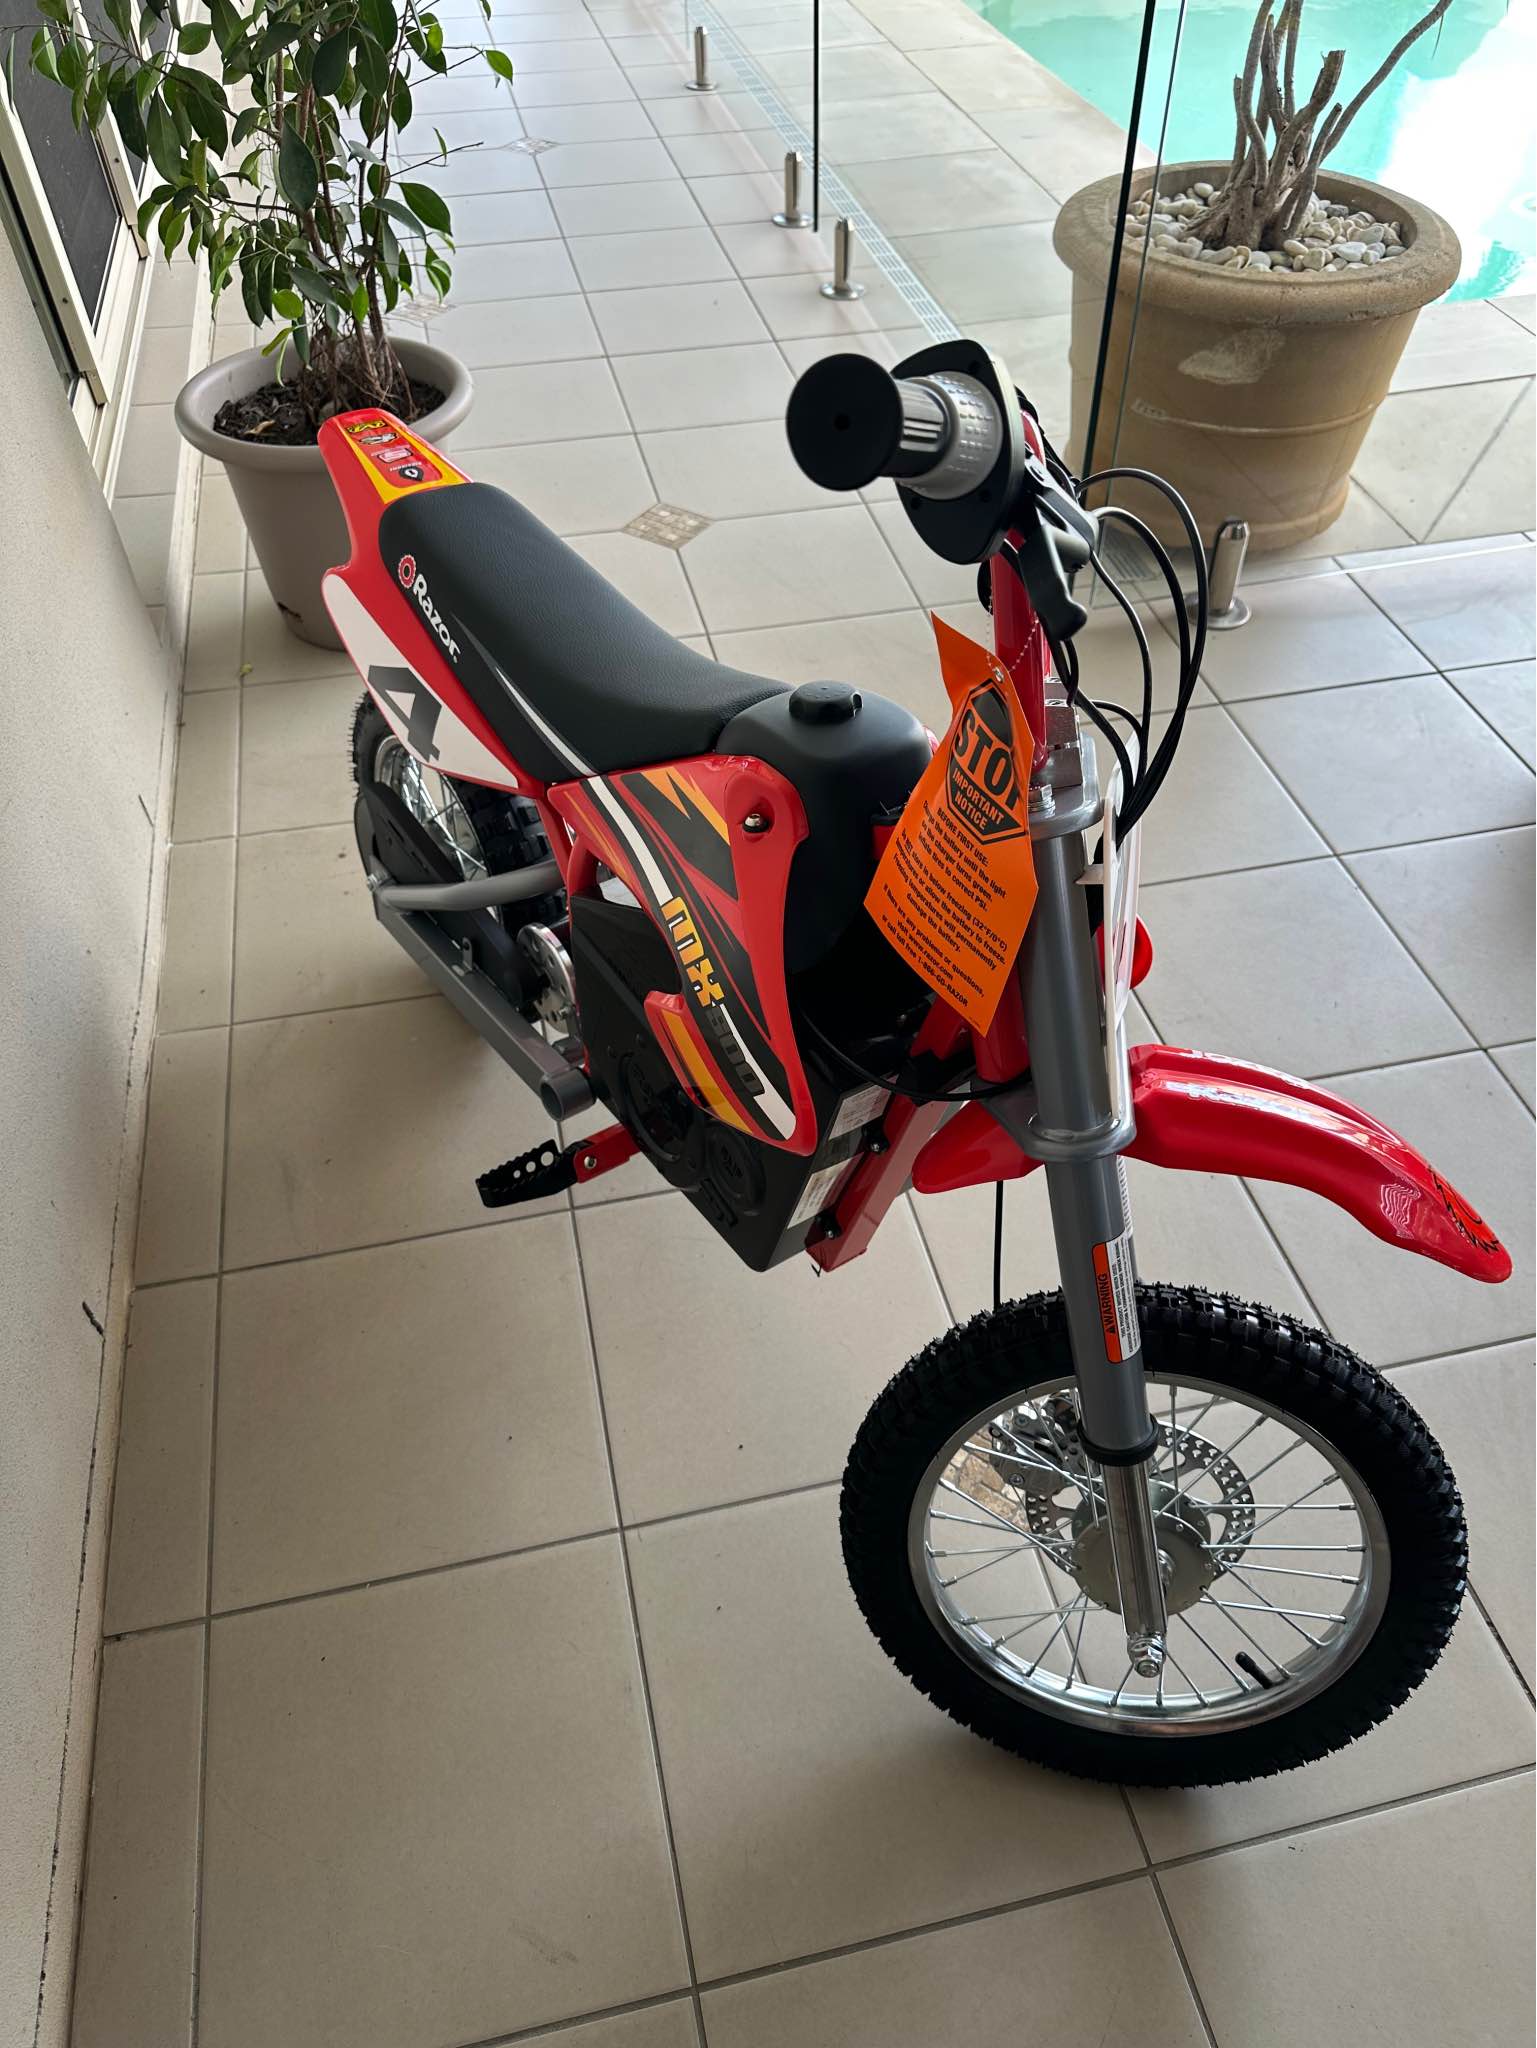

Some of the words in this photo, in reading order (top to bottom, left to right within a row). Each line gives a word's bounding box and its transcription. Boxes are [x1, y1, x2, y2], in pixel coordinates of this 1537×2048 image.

[412, 573, 462, 656] Razor
[367, 664, 442, 763] 4
[952, 767, 1005, 825] IMPORTANT
[954, 791, 988, 830] NOTICE
[937, 807, 957, 835] BEFORE
[957, 830, 974, 851] FIRST
[927, 828, 935, 842] the
[934, 840, 956, 865] charger
[956, 862, 972, 882] turns
[973, 880, 993, 903] green.
[932, 852, 945, 869] tires
[945, 866, 952, 877] to
[952, 875, 975, 900] correct
[935, 821, 943, 836] the
[943, 832, 964, 859] battery
[964, 855, 978, 872] until
[979, 868, 990, 884] the
[990, 880, 1006, 898] light
[919, 878, 926, 887] or
[925, 885, 941, 904] allow
[941, 901, 951, 915] the
[952, 911, 975, 937] battery
[976, 933, 983, 944] to
[984, 941, 1006, 965] freeze.
[923, 865, 929, 877] in
[929, 873, 946, 895] below
[947, 892, 972, 921] freezing
[906, 917, 917, 933] any
[916, 929, 944, 958] problems
[944, 956, 952, 967] or
[907, 893, 927, 919] damage
[927, 916, 938, 930] the
[938, 926, 961, 953] battery.
[909, 878, 944, 921] temperatures
[944, 918, 956, 933] will
[956, 931, 996, 970] permanently
[909, 933, 954, 981] www.razor.com
[1098, 1273, 1114, 1329] WARNING
